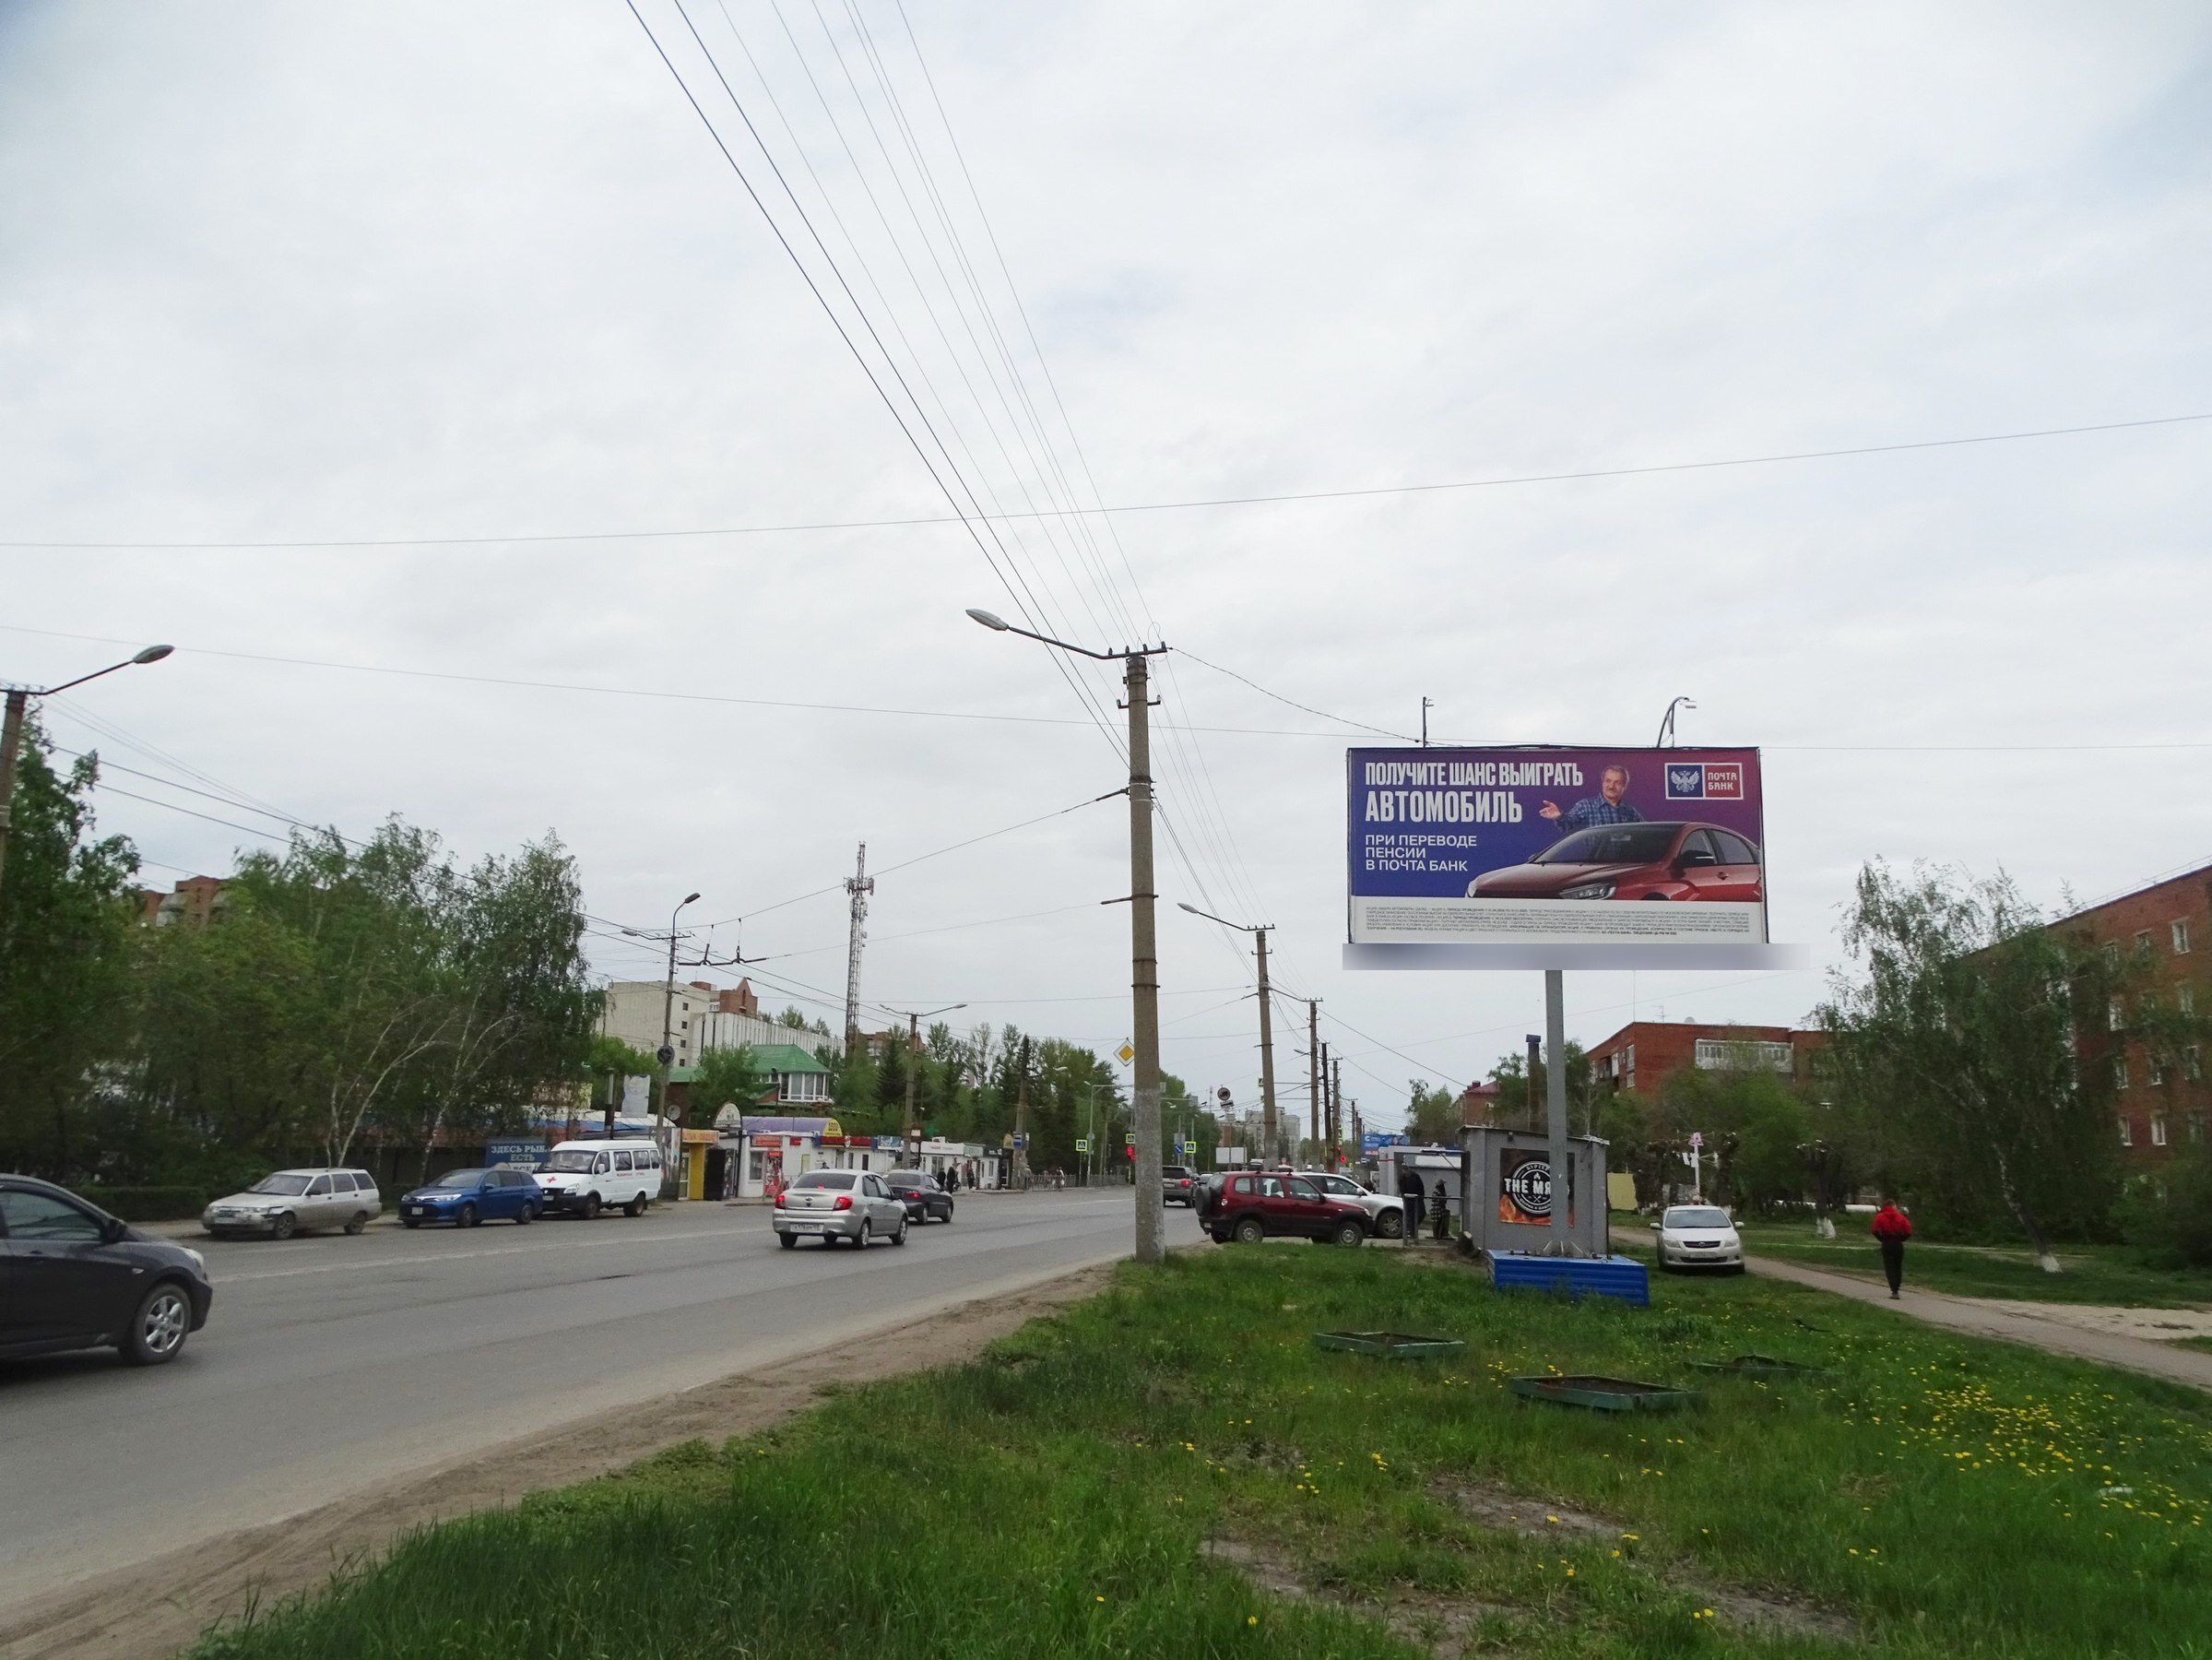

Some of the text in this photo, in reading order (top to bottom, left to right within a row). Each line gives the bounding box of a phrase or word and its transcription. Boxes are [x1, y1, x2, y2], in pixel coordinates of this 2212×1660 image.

[1365, 762, 1584, 787] ПОЛУЧИТЕ ШАНС ВЫИГРАТЬ
[1708, 772, 1737, 781] ПОЧТА
[1708, 781, 1734, 790] БАНК
[1365, 790, 1522, 823] АВТОМОБИЛЬ
[1365, 835, 1478, 848] ПРИ ПЕРЕВОДЕ
[1366, 847, 1426, 859] ПЕНСИИ
[1366, 860, 1469, 872] В ПОЧТА БАНК
[491, 1144, 523, 1154] ЗДЕСЬ
[510, 1153, 536, 1161] ЕСТЬ
[1504, 1178, 1530, 1194] THE
